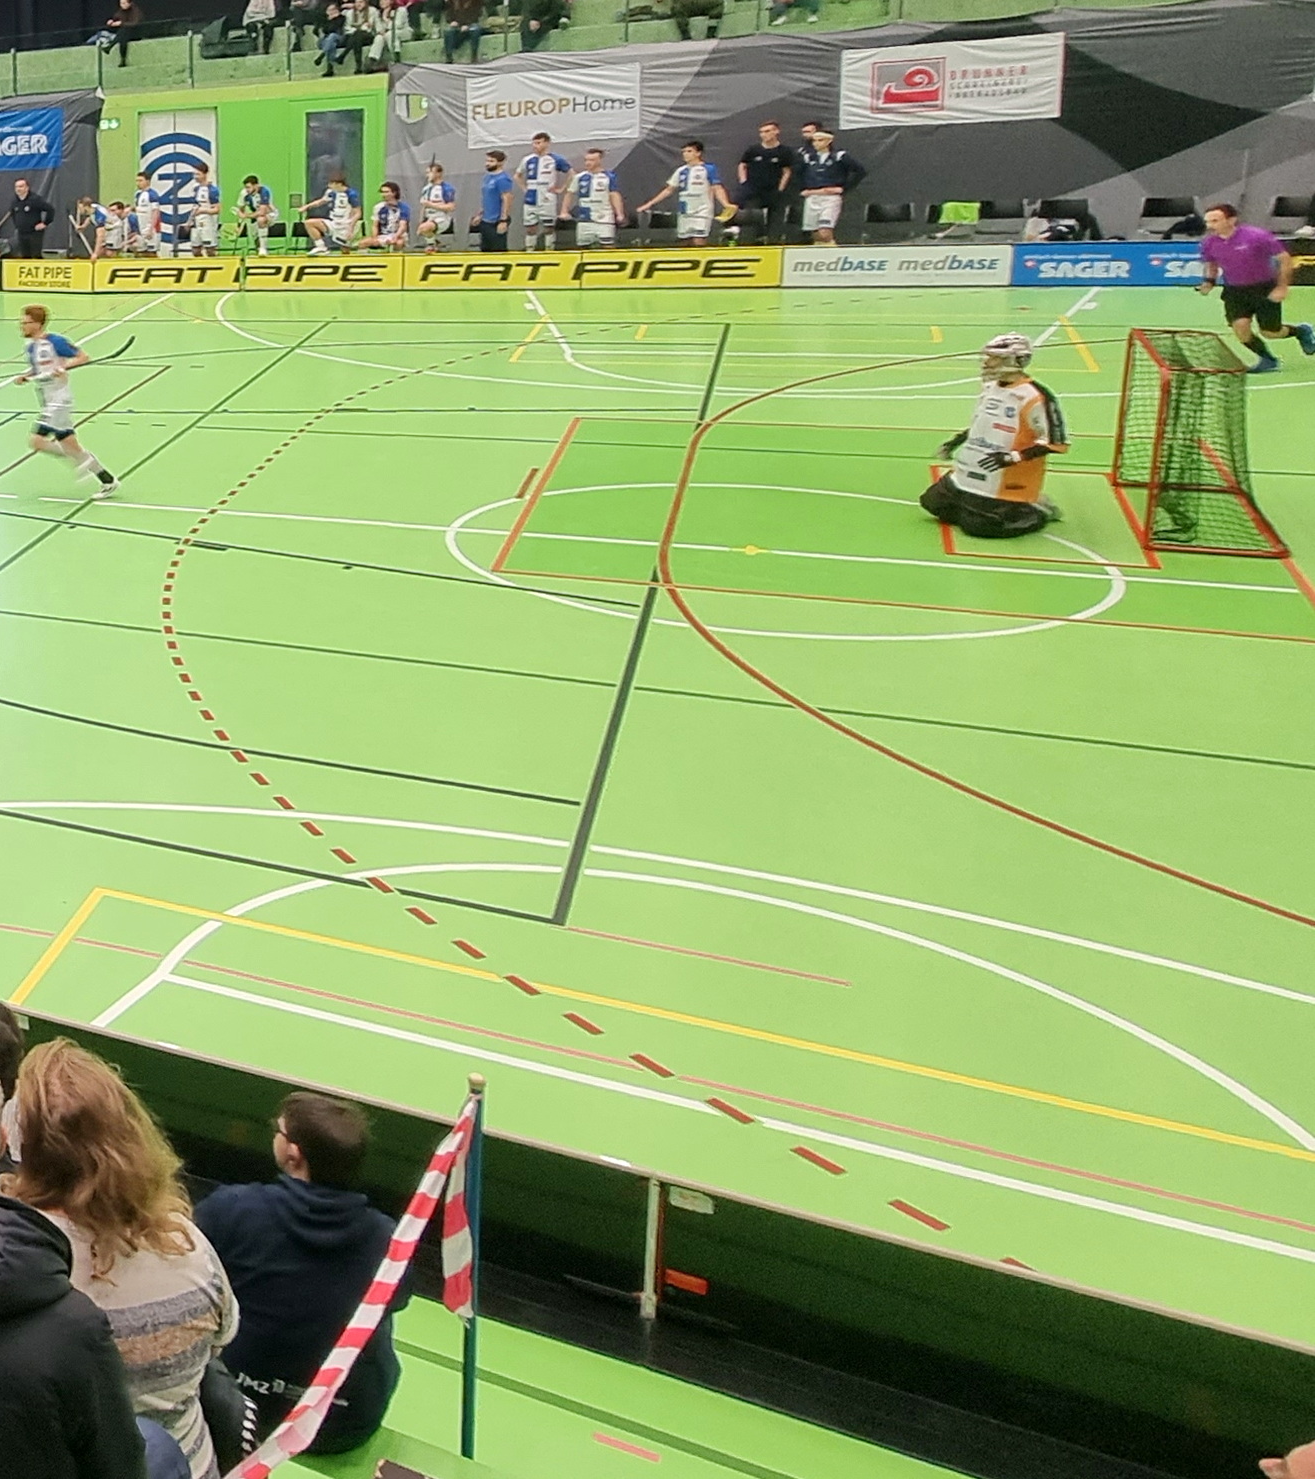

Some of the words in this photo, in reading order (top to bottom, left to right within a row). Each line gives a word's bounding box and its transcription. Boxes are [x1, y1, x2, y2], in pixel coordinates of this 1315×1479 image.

[471, 96, 636, 120] FLEUROPHome
[18, 266, 40, 278] FAT
[43, 267, 72, 279] PIPE
[107, 266, 223, 284] FAT
[233, 265, 388, 284] PIPE
[419, 262, 561, 282] FAT
[572, 259, 761, 281] PIPE
[1038, 261, 1131, 278] SAGER
